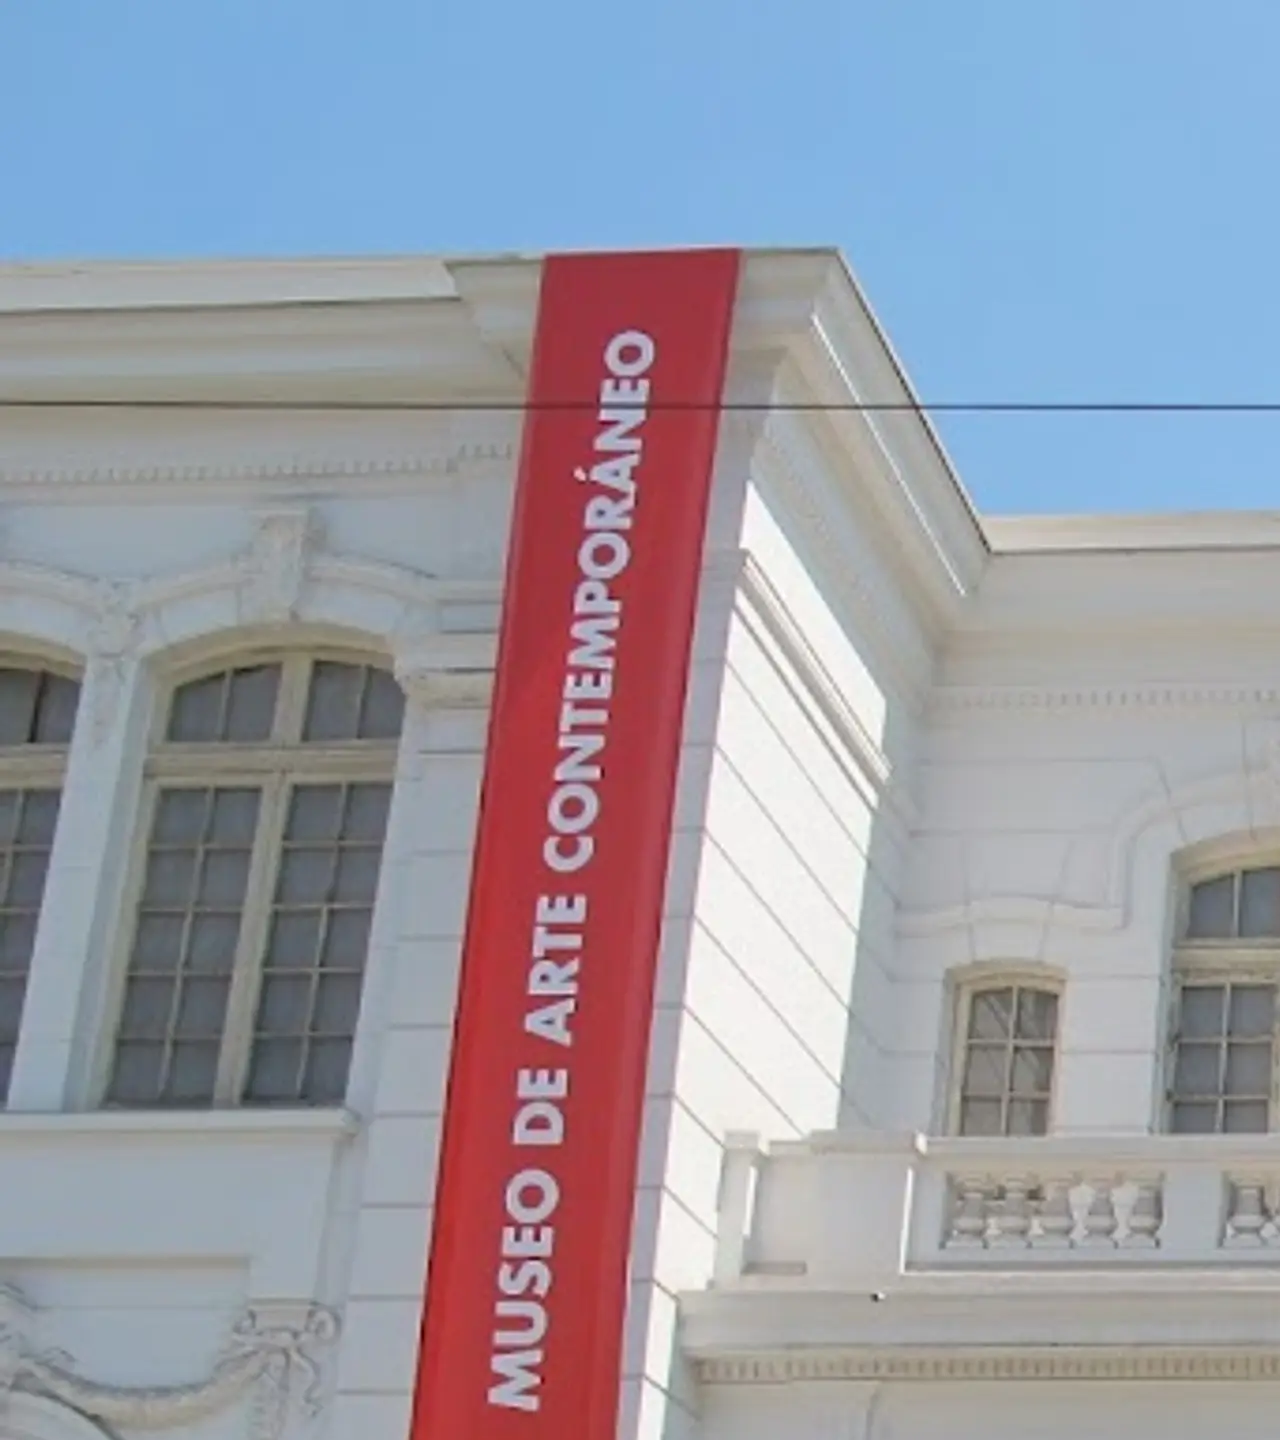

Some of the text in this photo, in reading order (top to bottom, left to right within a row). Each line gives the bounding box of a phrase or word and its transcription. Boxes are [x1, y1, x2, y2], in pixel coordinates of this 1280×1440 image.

[488, 330, 657, 1412] MUSEO DE ARTE CONTEMPORÁNEO
